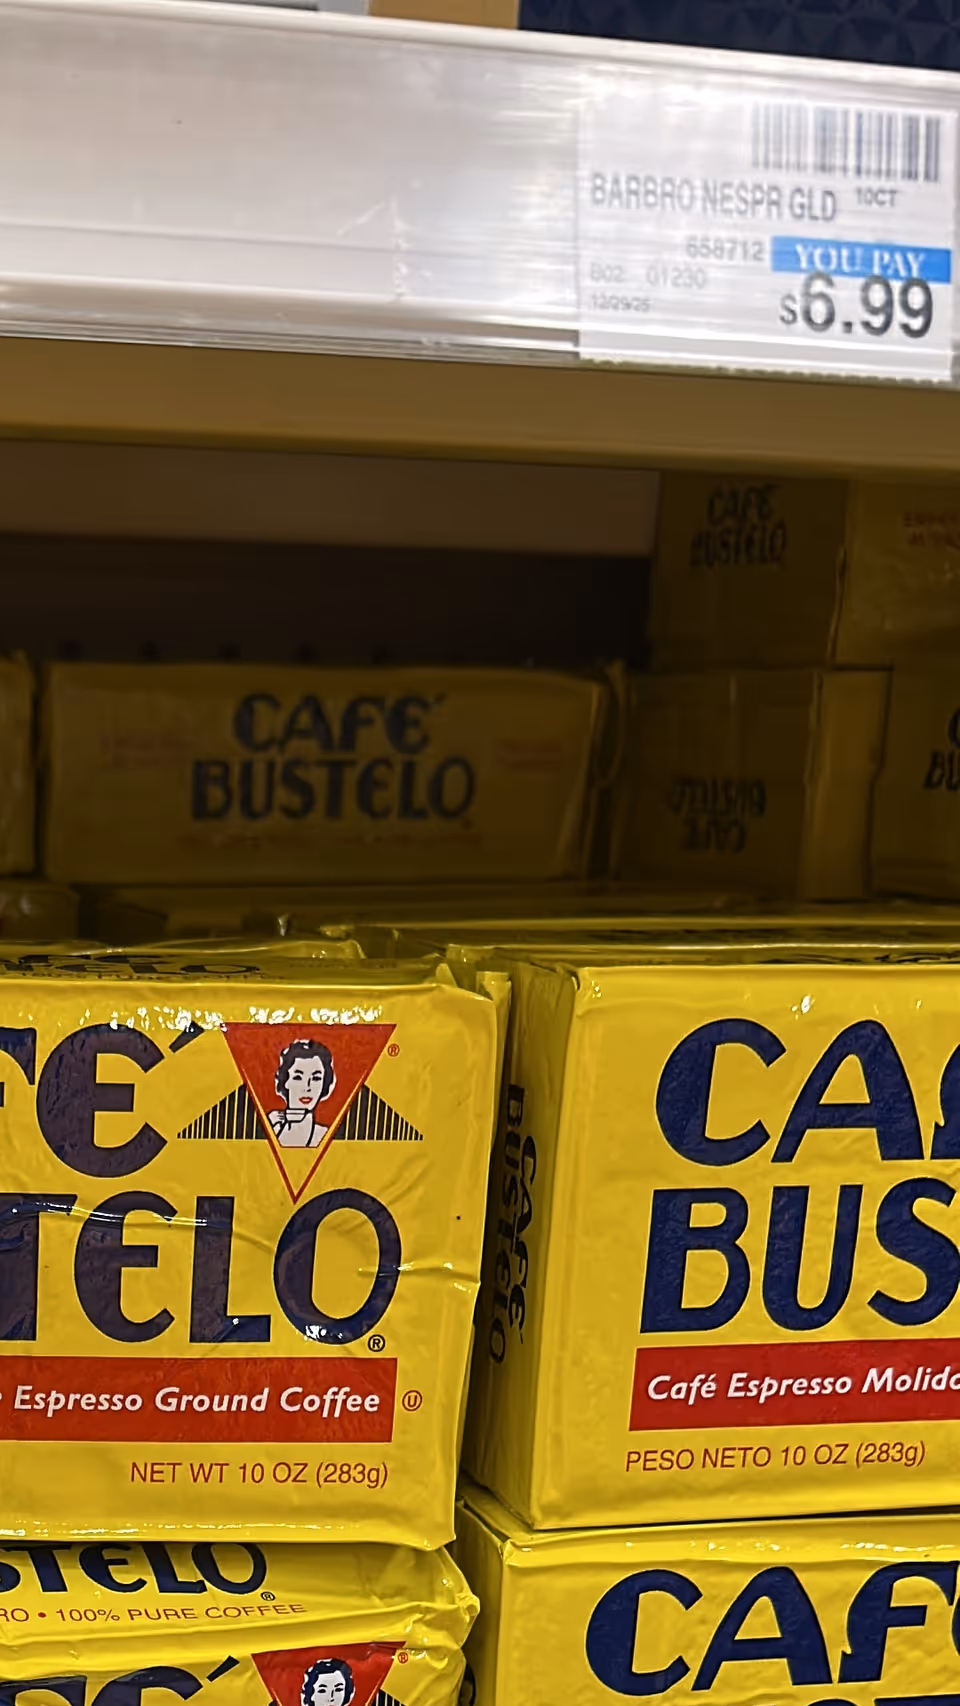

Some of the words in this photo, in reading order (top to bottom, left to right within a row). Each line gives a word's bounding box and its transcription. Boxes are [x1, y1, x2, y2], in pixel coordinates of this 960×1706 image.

[591, 172, 692, 210] BARBRO
[701, 180, 782, 220] NESPR
[790, 188, 837, 222] GLD
[855, 187, 898, 207] 10CT
[795, 243, 866, 271] YOU
[871, 248, 926, 277] PAY
[779, 271, 933, 339] $6.99
[192, 756, 475, 821] BUSTELO
[654, 1017, 960, 1167] CA
[639, 1176, 960, 1334] BUS
[13, 1384, 143, 1417] Espresso
[154, 1386, 269, 1413] Ground
[279, 1386, 380, 1418] Coffee
[648, 1372, 717, 1406] Café
[726, 1370, 853, 1404] Espresso
[861, 1365, 960, 1393] Molido
[131, 1461, 182, 1484] NET
[189, 1462, 230, 1484] WT
[238, 1462, 265, 1484] 10
[271, 1462, 308, 1484] OZ
[315, 1462, 389, 1490] (283g)
[625, 1447, 694, 1472] PESO
[701, 1445, 771, 1470] NETO
[781, 1446, 806, 1467] 10
[814, 1443, 849, 1465] OZ
[855, 1441, 926, 1469] (283g)
[55, 1607, 120, 1623] 100%
[128, 1606, 198, 1622] PURE
[203, 1601, 308, 1620] COFFEE
[585, 1561, 960, 1697] CAF
